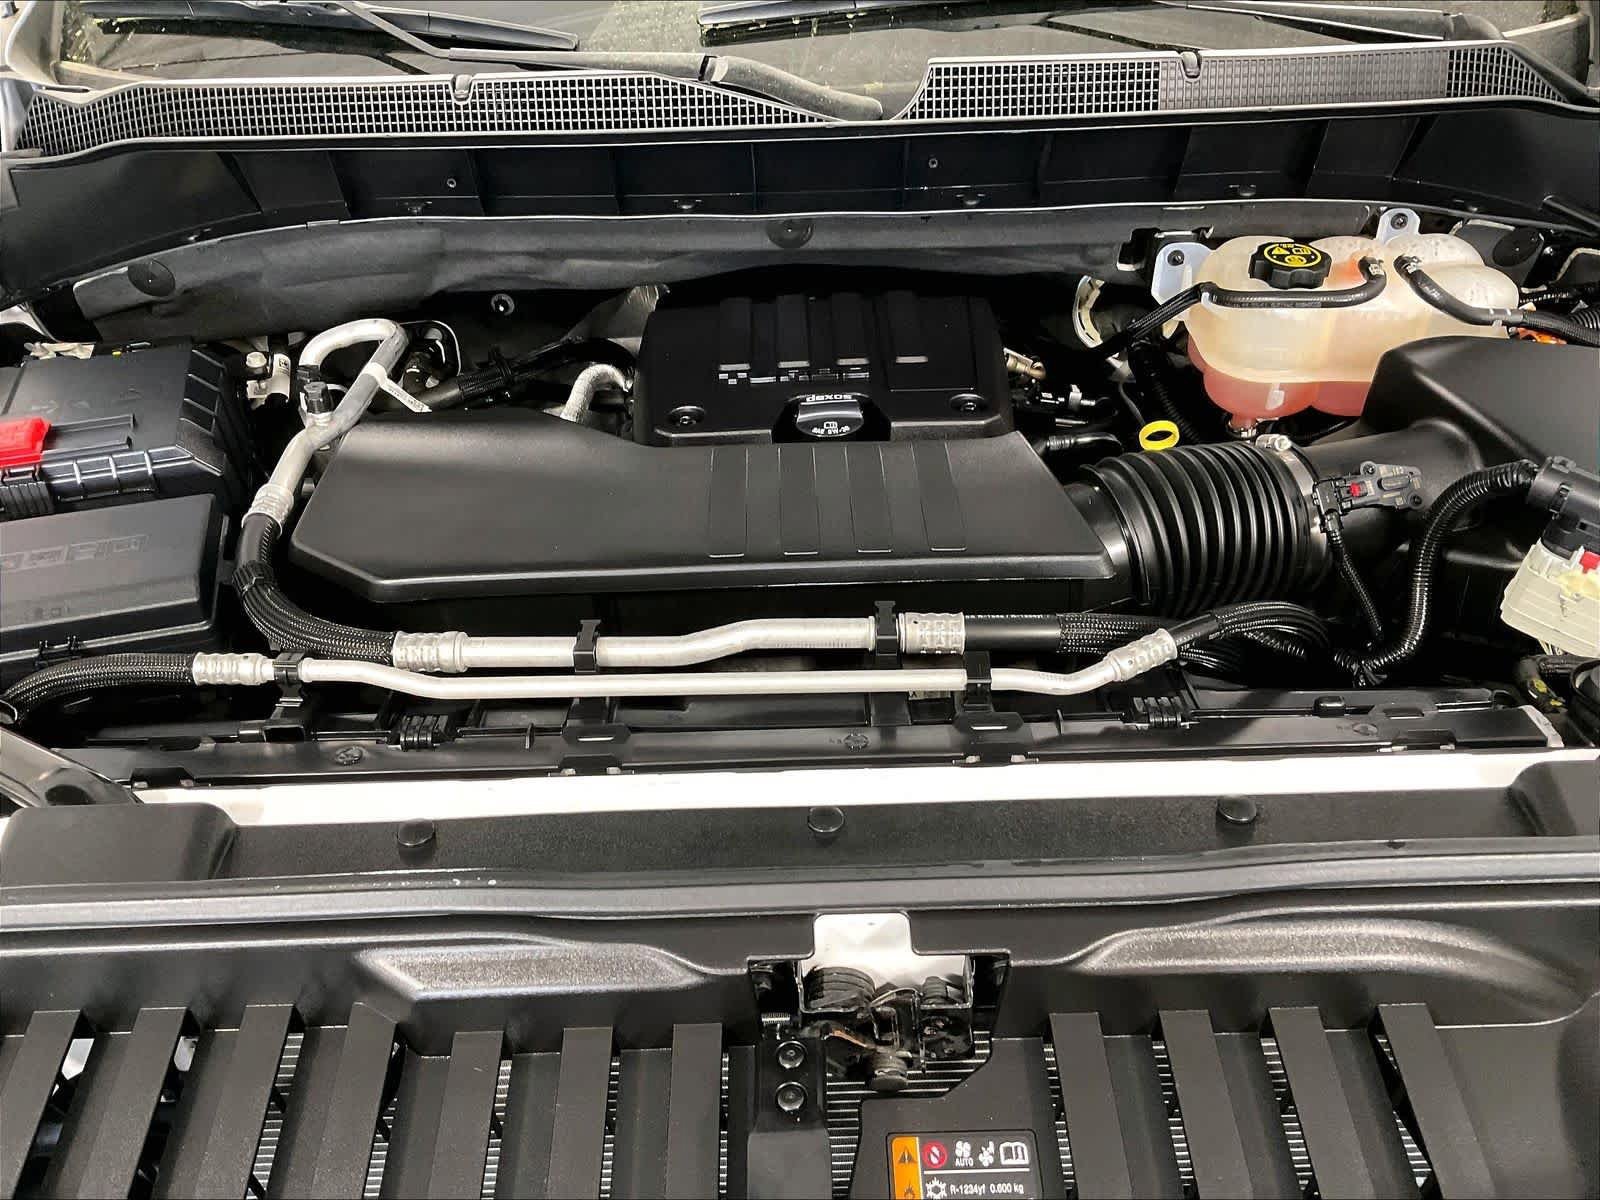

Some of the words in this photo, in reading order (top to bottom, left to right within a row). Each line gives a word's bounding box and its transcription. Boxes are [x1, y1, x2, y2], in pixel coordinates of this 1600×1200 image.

[806, 394, 852, 402] dexos
[955, 1157, 974, 1167] AUTO
[950, 1184, 986, 1196] R-1234yf
[1013, 1183, 1024, 1195] kg
